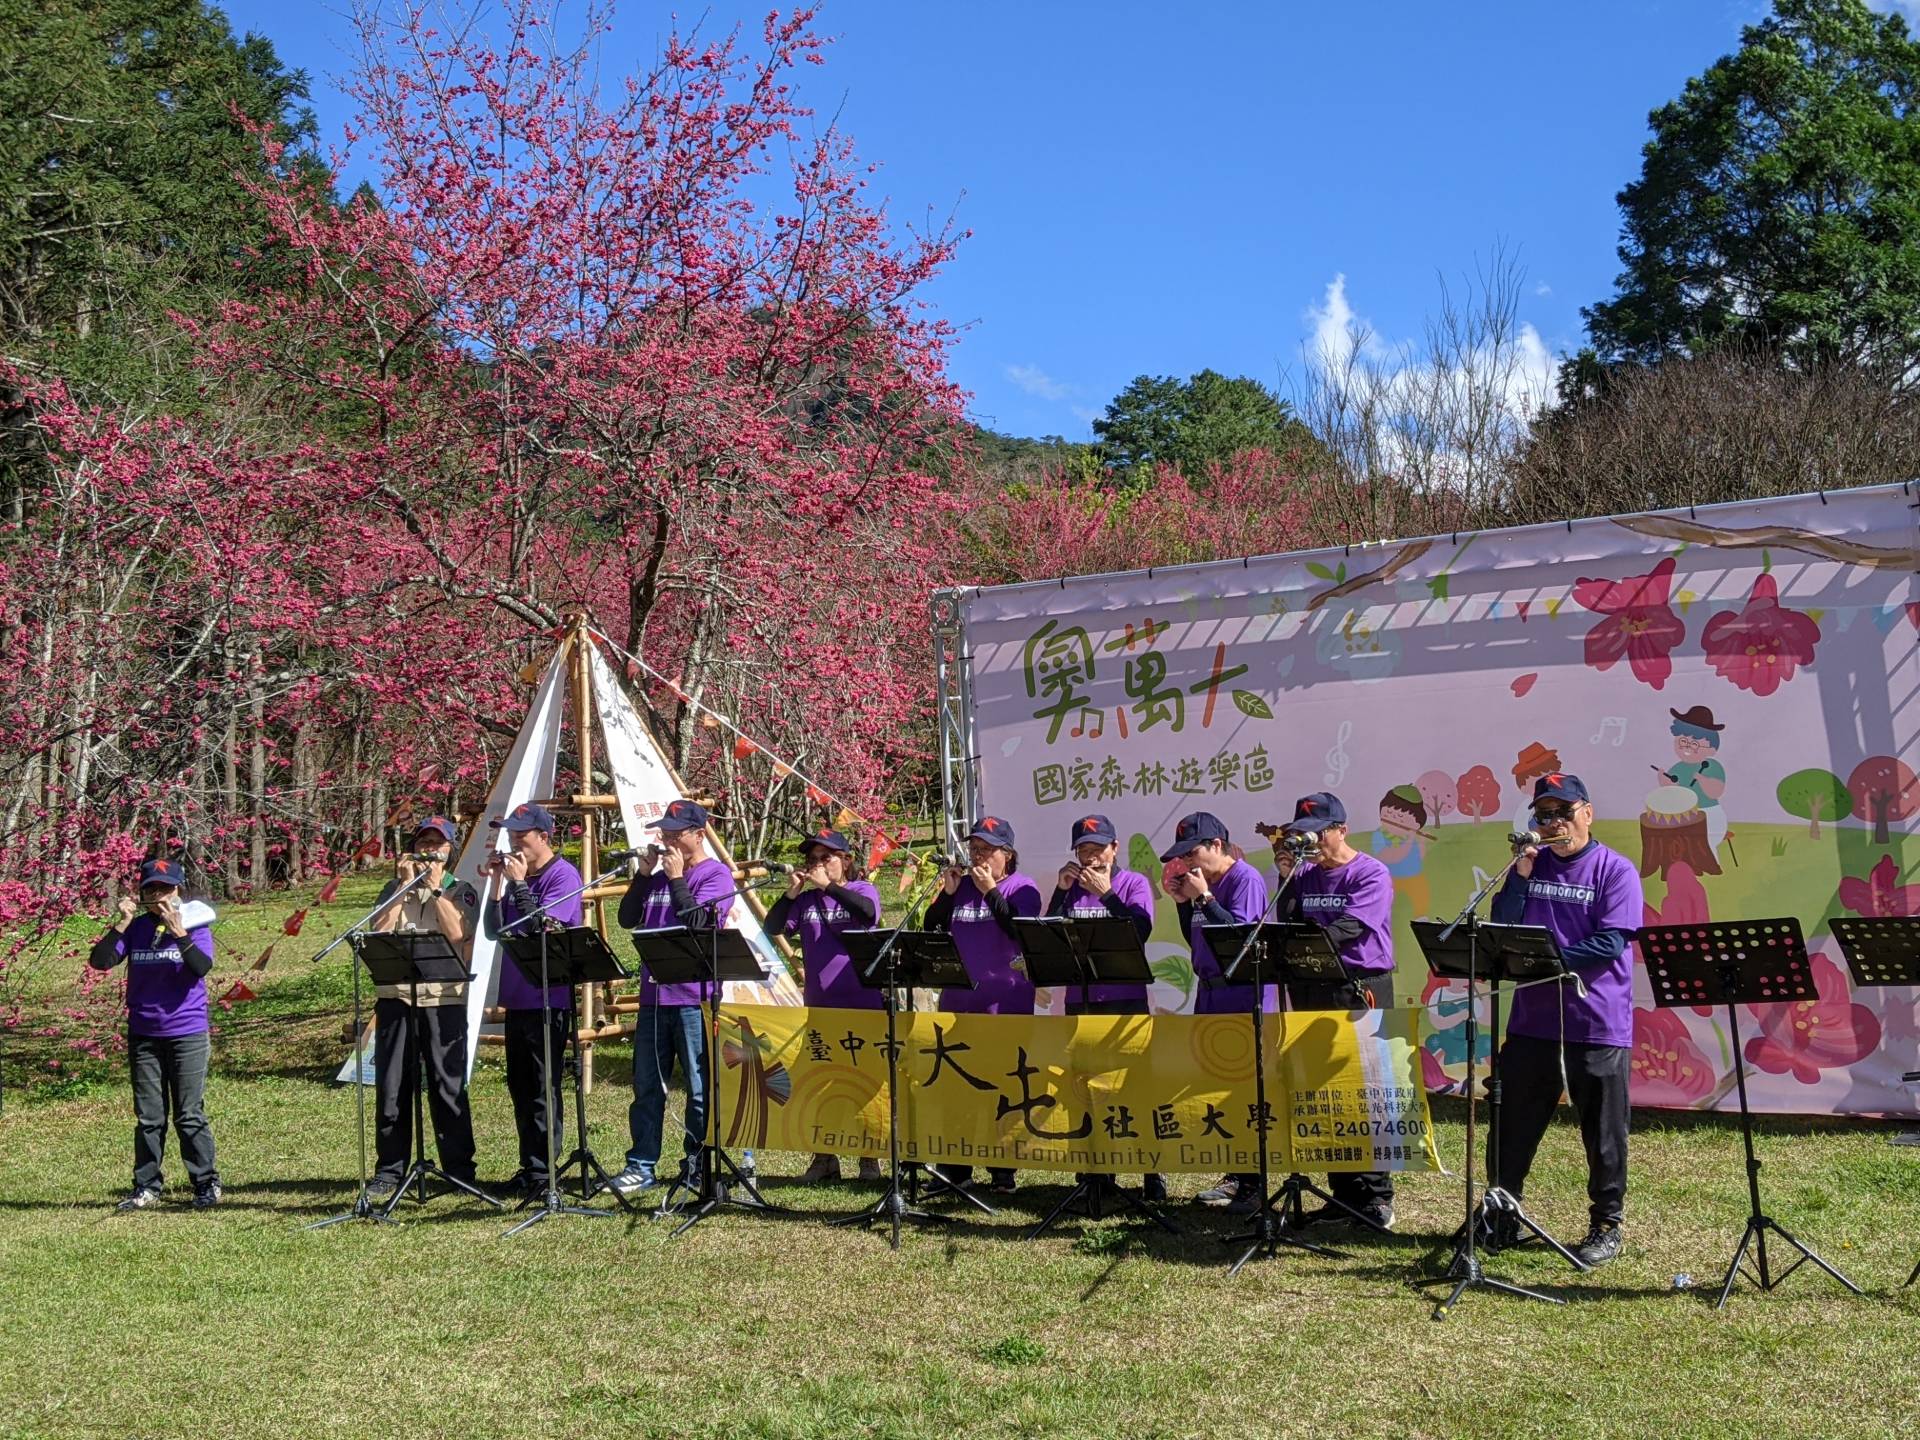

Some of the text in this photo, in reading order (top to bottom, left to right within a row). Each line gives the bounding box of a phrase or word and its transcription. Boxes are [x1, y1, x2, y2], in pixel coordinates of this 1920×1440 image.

[1033, 743, 1275, 806] 國家森林遊樂區
[811, 1125, 1283, 1169] Taichung Urban Community College
[1297, 1120, 1428, 1138] 04-24074600
